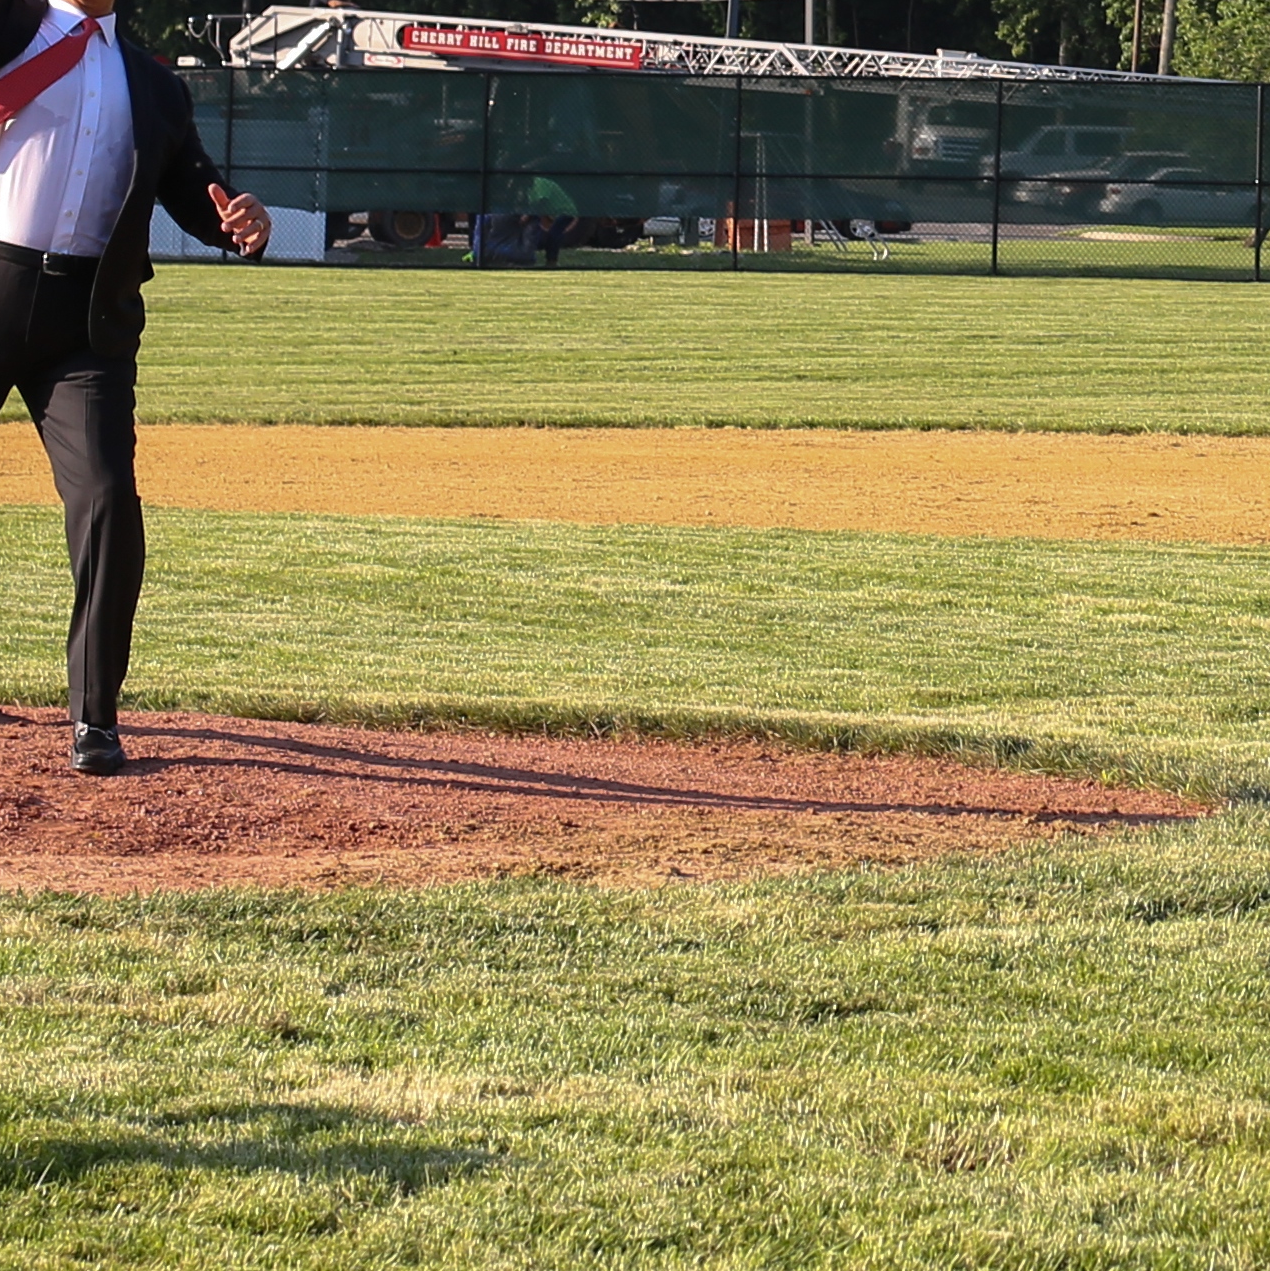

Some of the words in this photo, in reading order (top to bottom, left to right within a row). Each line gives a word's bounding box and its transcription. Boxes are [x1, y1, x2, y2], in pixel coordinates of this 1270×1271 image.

[411, 30, 463, 47] CHERRY
[469, 34, 500, 50] HILL
[506, 37, 537, 52] FIRE
[544, 41, 633, 60] DEPARTMENT
